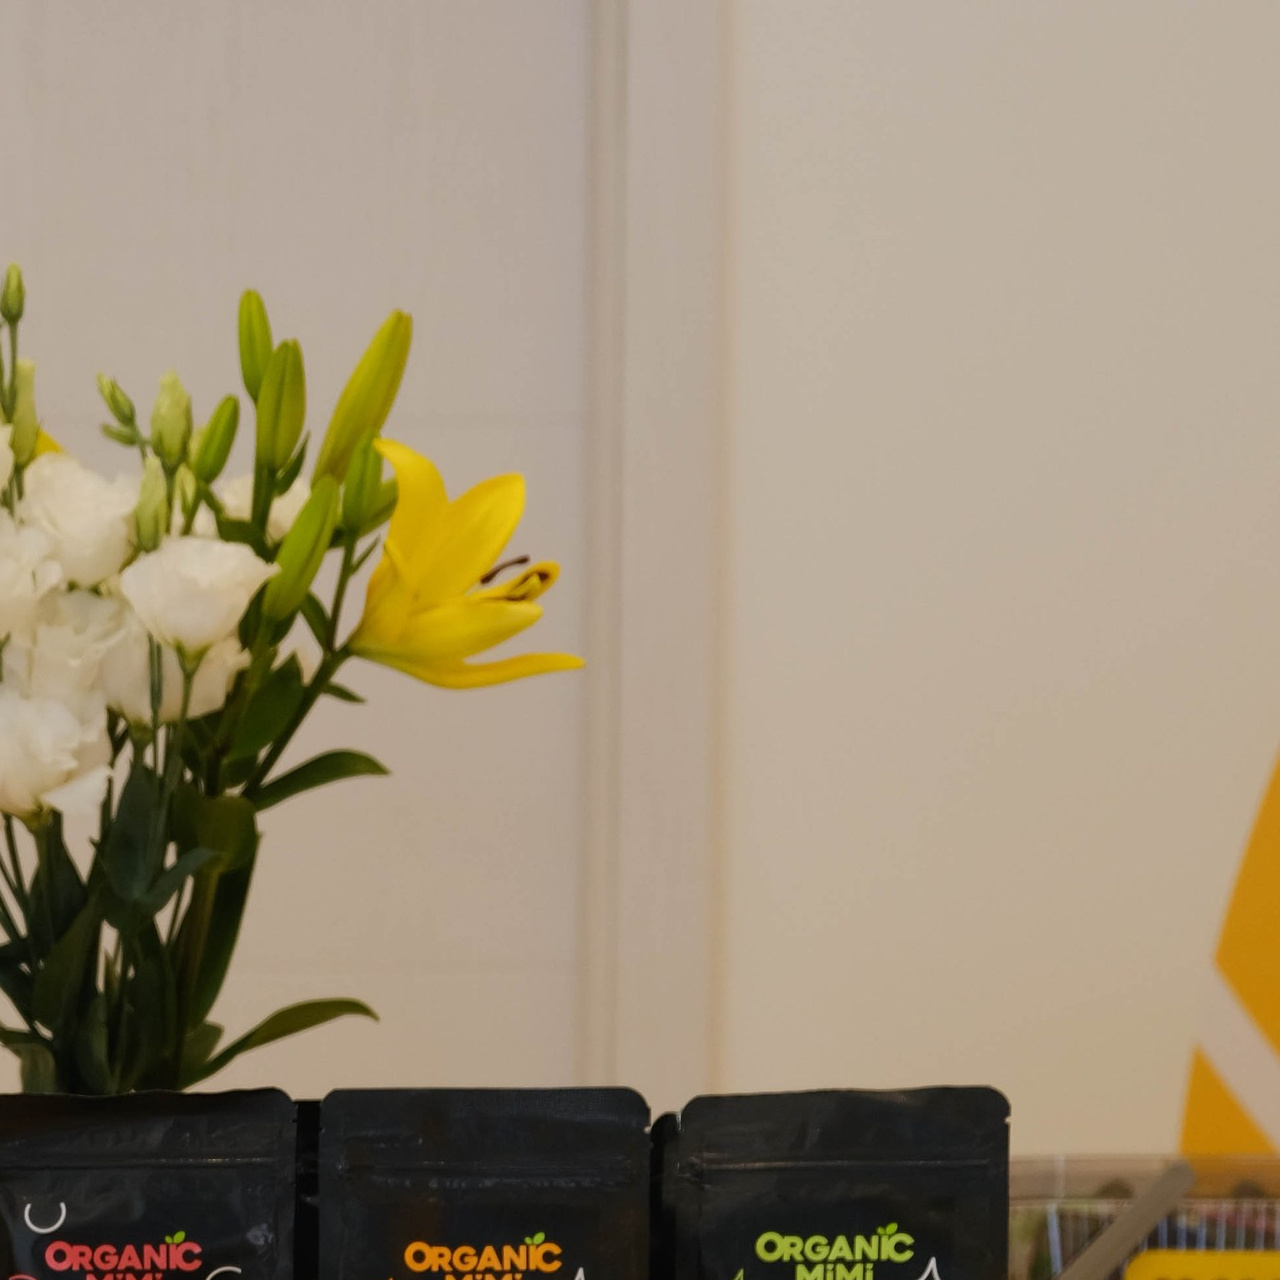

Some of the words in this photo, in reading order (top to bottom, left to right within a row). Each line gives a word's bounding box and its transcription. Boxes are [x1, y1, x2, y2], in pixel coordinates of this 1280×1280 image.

[45, 1240, 202, 1271] ORGANIC
[404, 1241, 562, 1273] ORGANIC
[755, 1231, 914, 1263] ORGANIC
